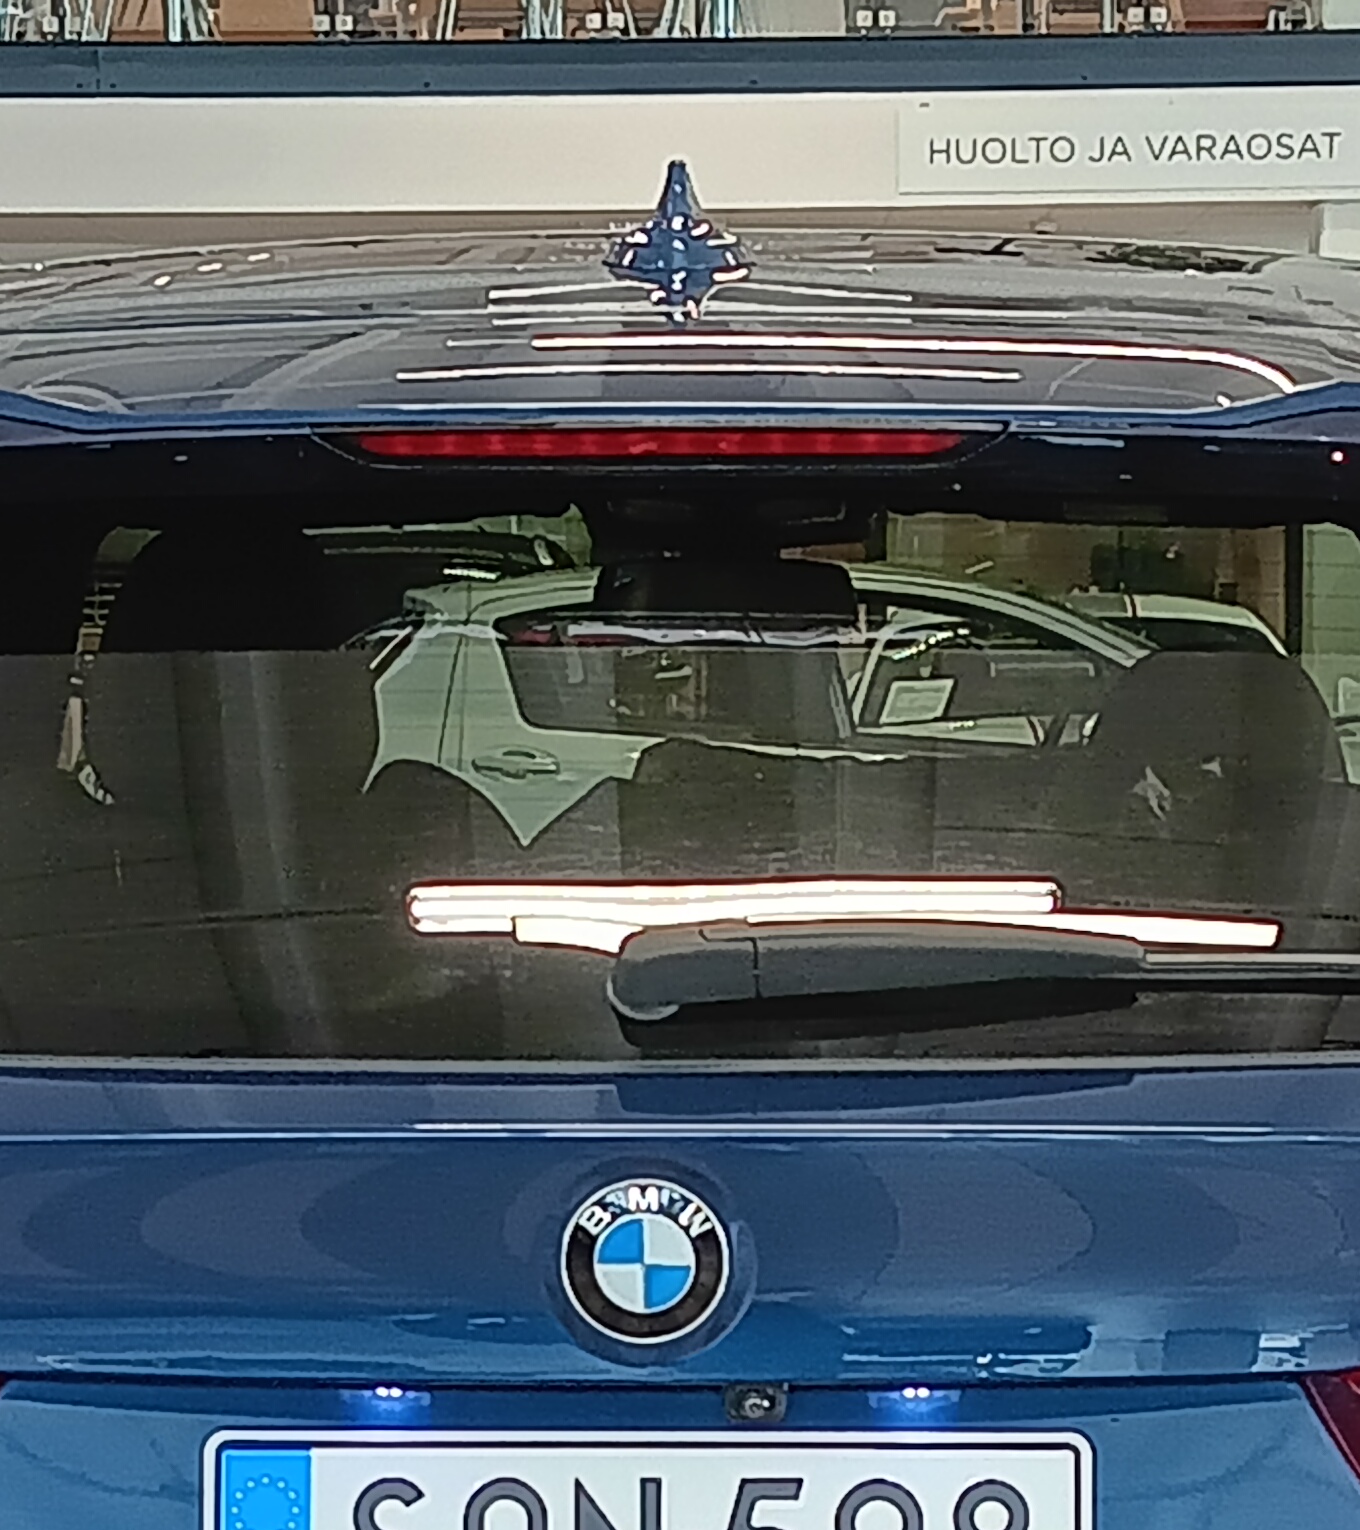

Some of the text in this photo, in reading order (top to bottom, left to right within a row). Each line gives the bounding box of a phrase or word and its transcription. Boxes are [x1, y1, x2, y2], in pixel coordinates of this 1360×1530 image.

[928, 131, 1342, 165] HUOLTO JA VARAOSAT
[578, 1186, 713, 1238] BMW
